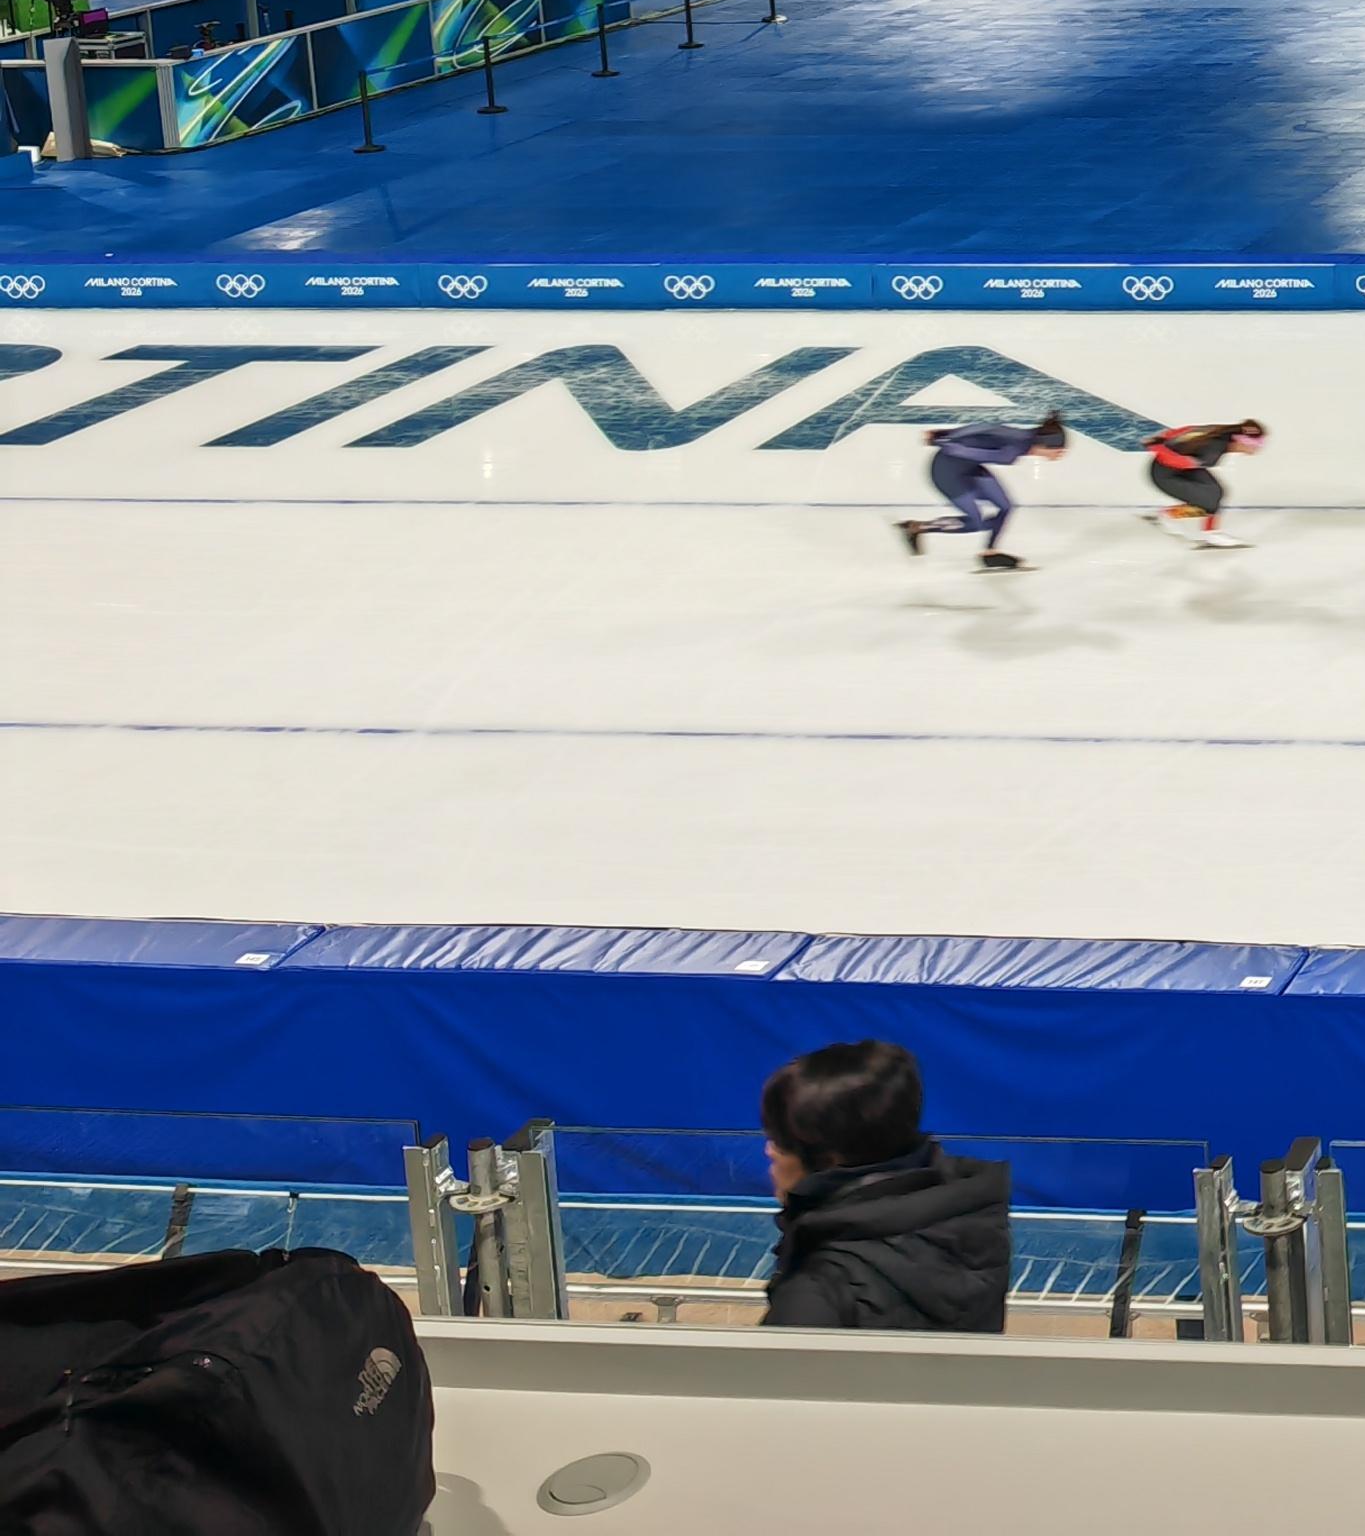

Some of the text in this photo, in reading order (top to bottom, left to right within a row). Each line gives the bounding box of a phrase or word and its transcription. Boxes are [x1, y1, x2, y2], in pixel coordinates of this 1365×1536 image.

[84, 277, 178, 287] MILANO CORTINA
[304, 276, 399, 287] MILANO CORTINA
[527, 278, 624, 288] MILANO CORTINA
[754, 278, 852, 288] MILANO CORTINA
[983, 278, 1082, 289] MILANO CORTINA
[1214, 278, 1315, 289] MILANO CORTINA
[120, 286, 143, 297] 2026
[340, 285, 364, 296] 2026
[564, 287, 589, 298] 2026
[791, 287, 816, 297] 2026
[1021, 287, 1046, 298] 2026
[1252, 288, 1277, 299] 2026
[0, 344, 1175, 453] TINA
